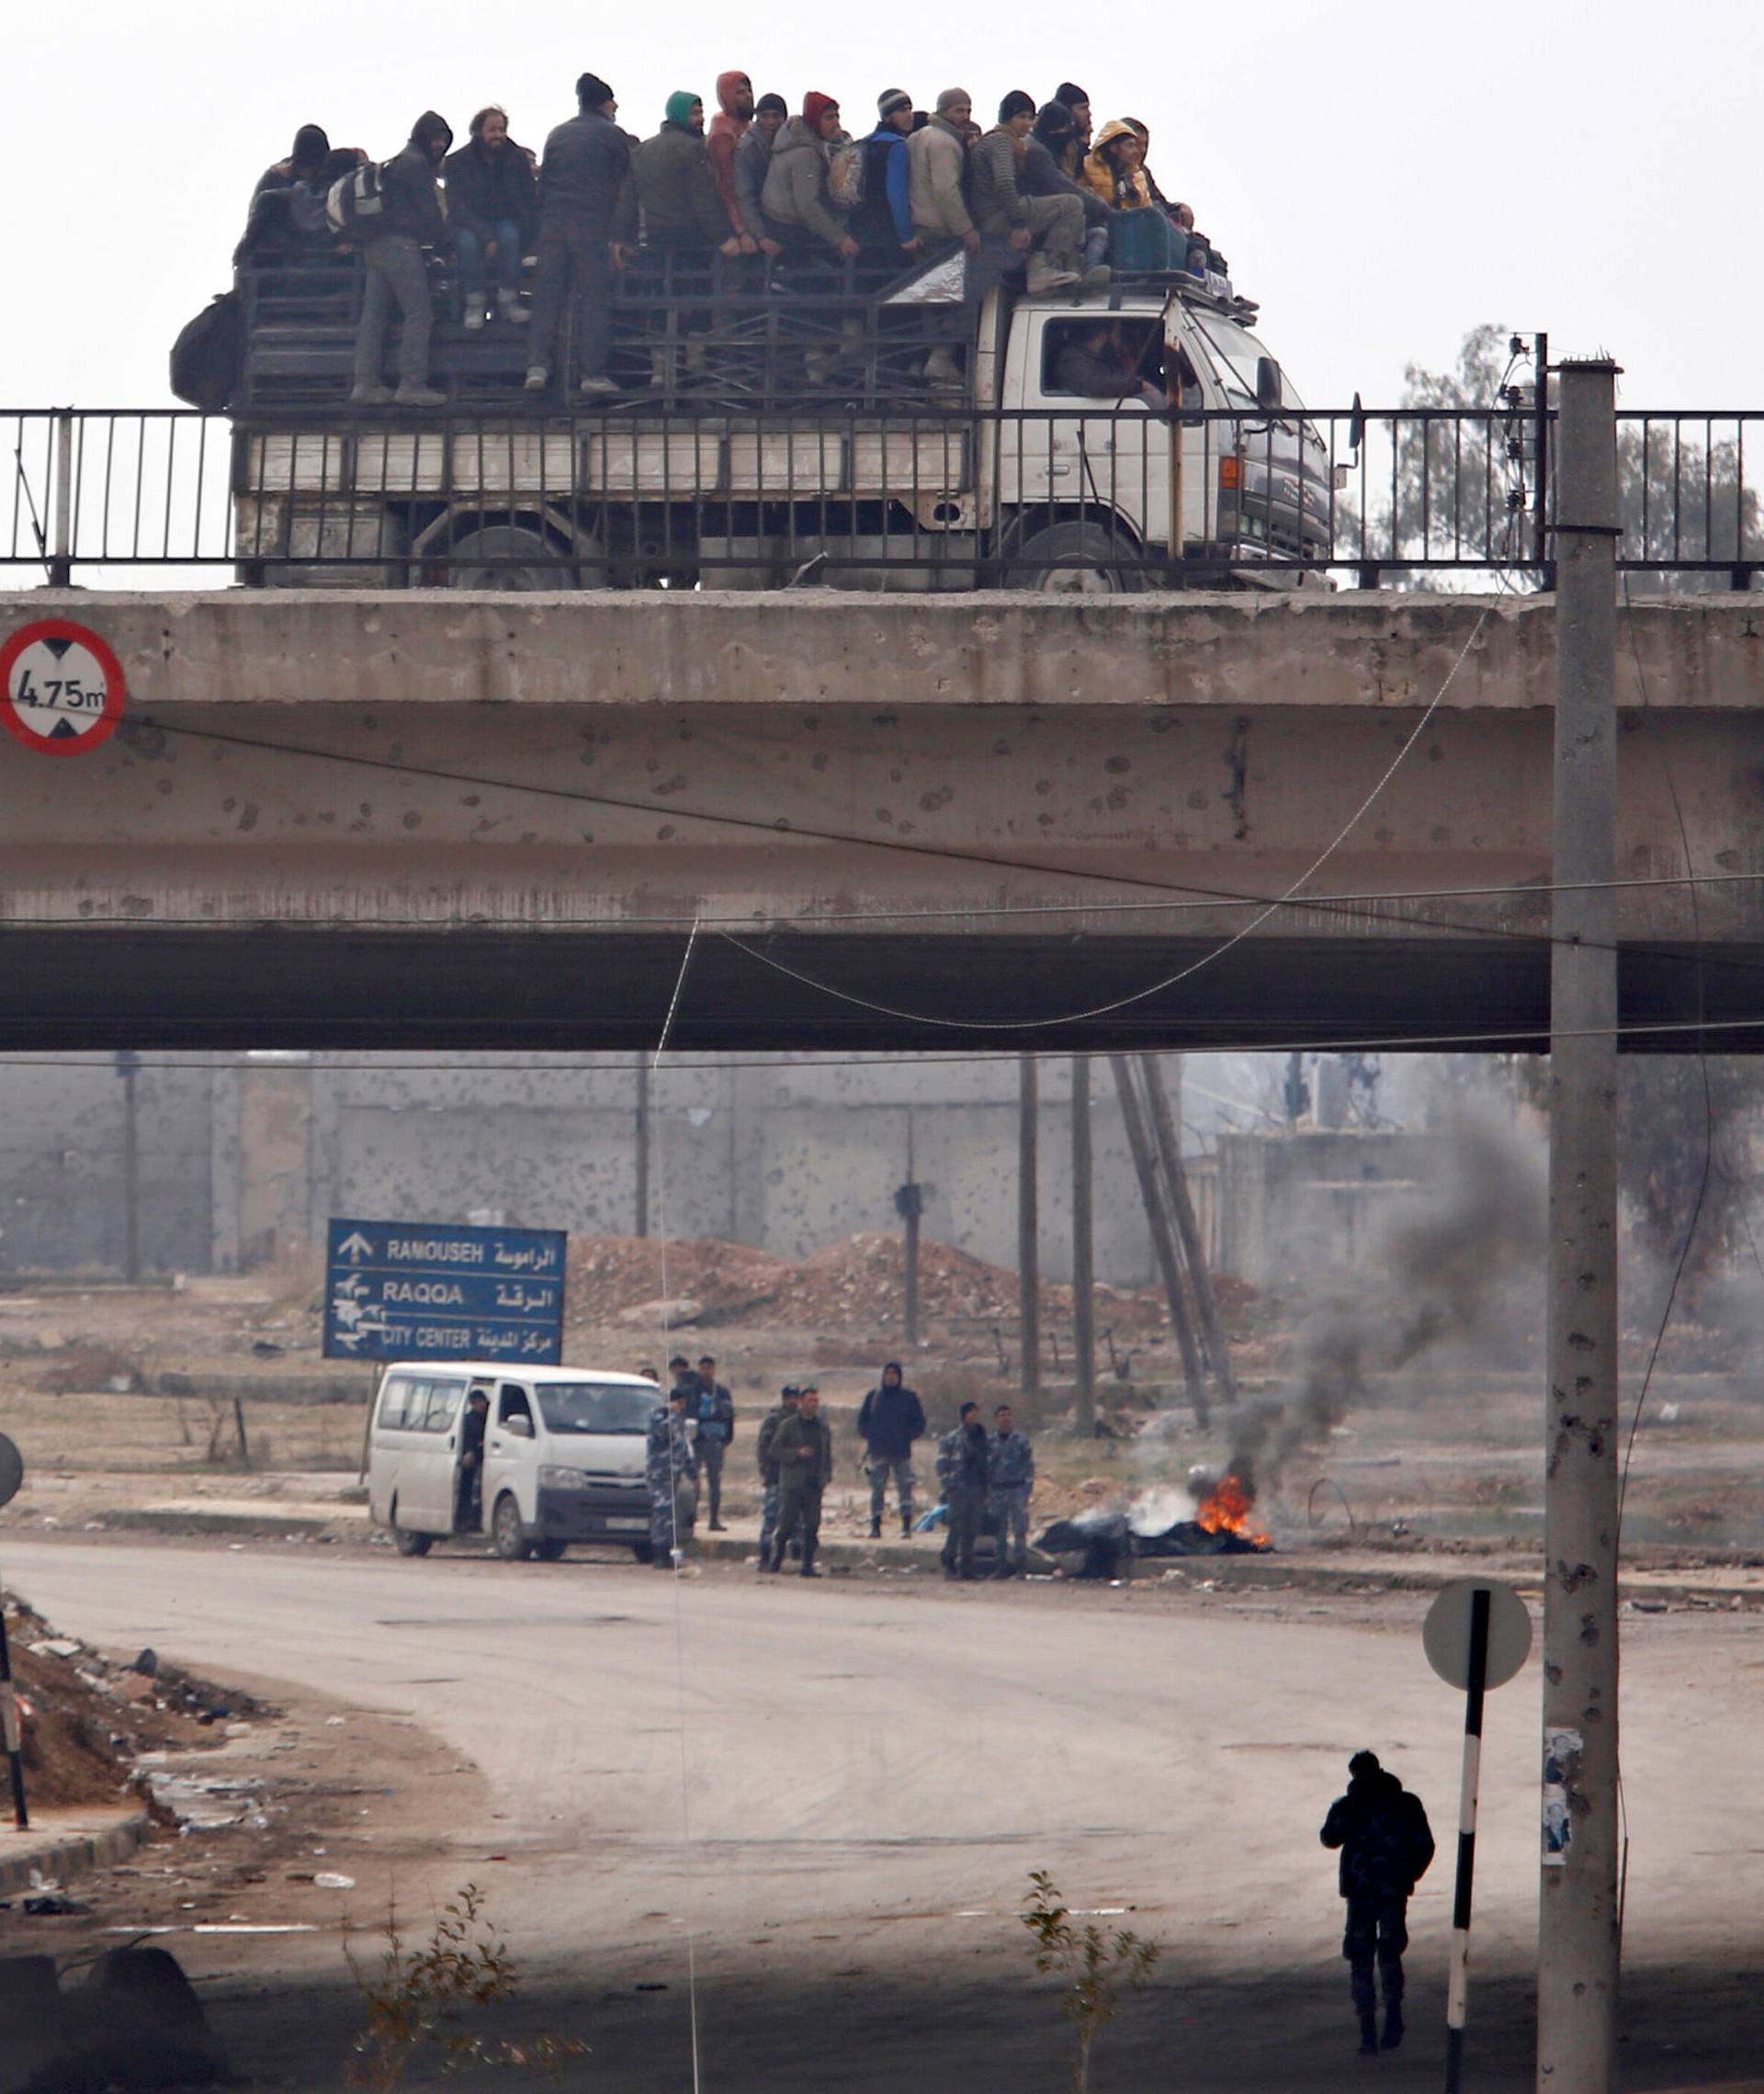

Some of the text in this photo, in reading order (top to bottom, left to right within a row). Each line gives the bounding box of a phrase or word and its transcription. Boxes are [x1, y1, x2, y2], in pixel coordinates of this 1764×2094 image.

[17, 669, 107, 707] 4.75m
[387, 1239, 485, 1263] RAMOUSEH
[494, 1241, 556, 1271] الراموسة
[382, 1281, 463, 1305] RAQQA
[496, 1284, 553, 1312] الرقة
[382, 1326, 470, 1349] CITY CENTER
[477, 1327, 551, 1353] مركز المدينة
